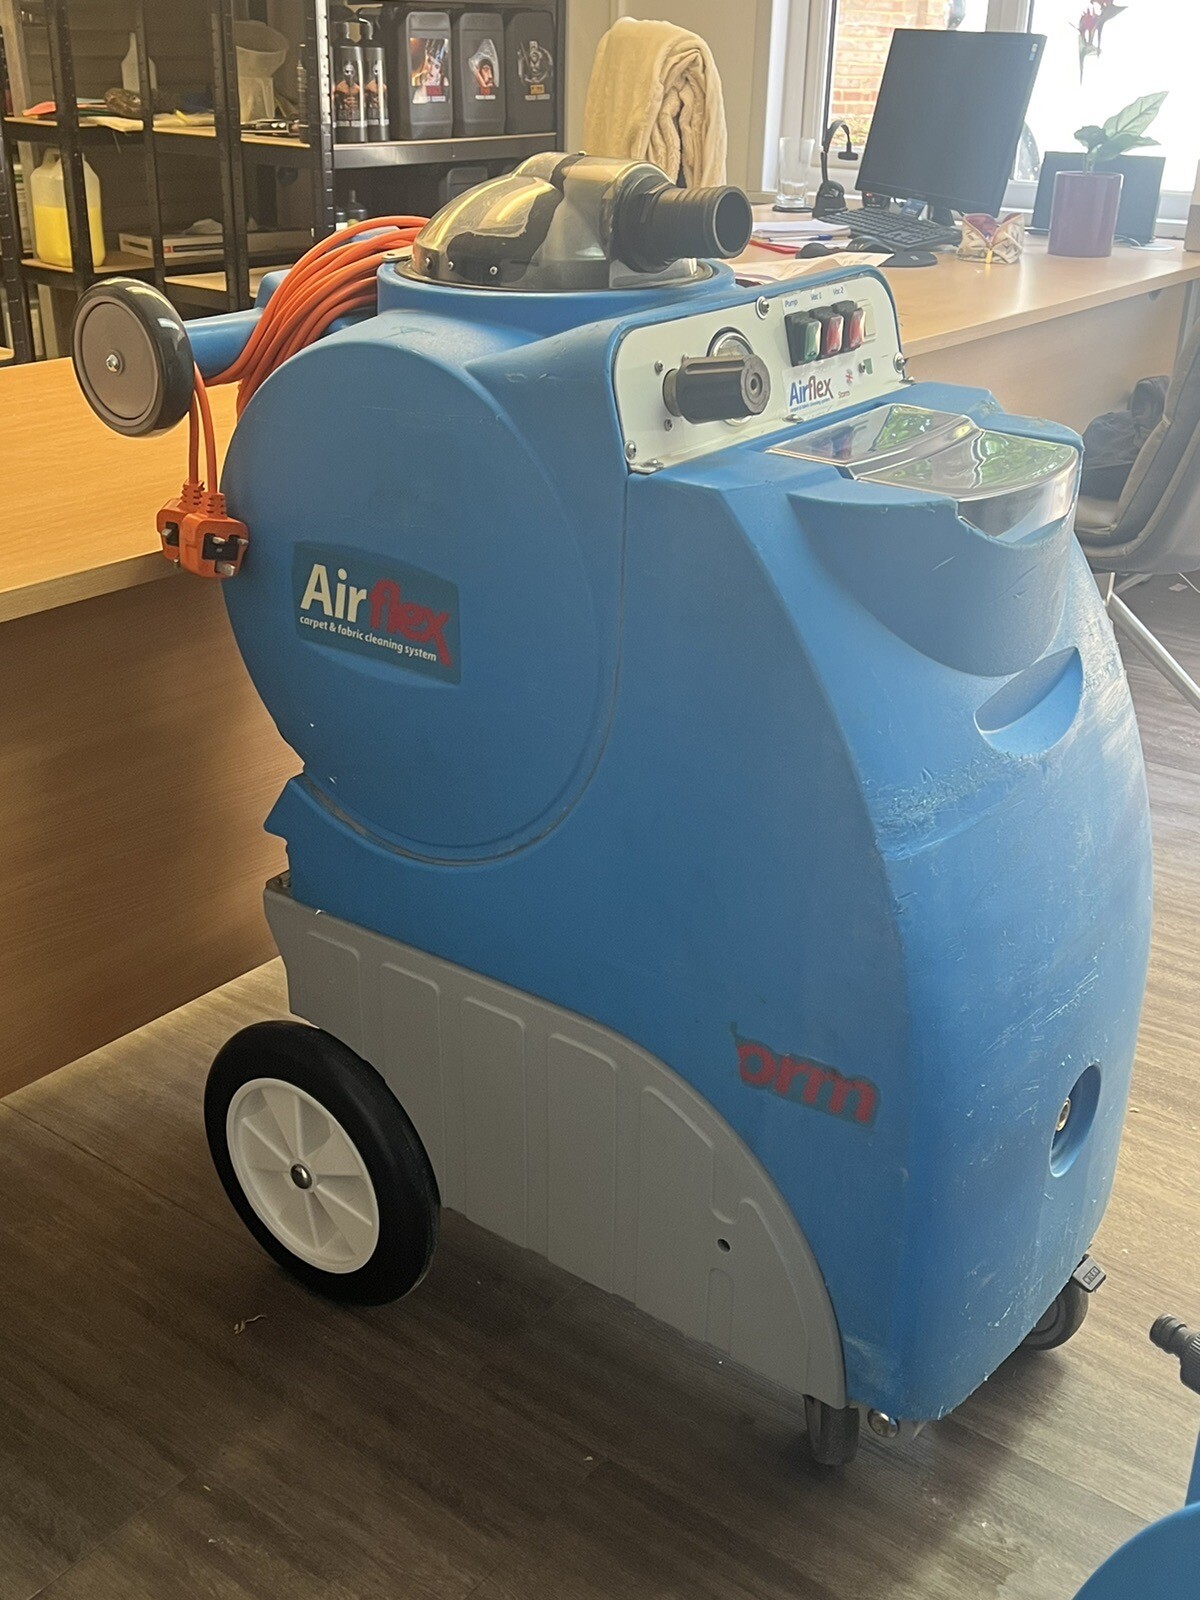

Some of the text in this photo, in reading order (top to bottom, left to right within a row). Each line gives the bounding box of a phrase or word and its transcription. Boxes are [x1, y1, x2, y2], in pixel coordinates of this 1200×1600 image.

[789, 375, 834, 407] Airflex
[300, 563, 452, 667] Airflex
[299, 616, 437, 662] carpet & fabric cleaning system
